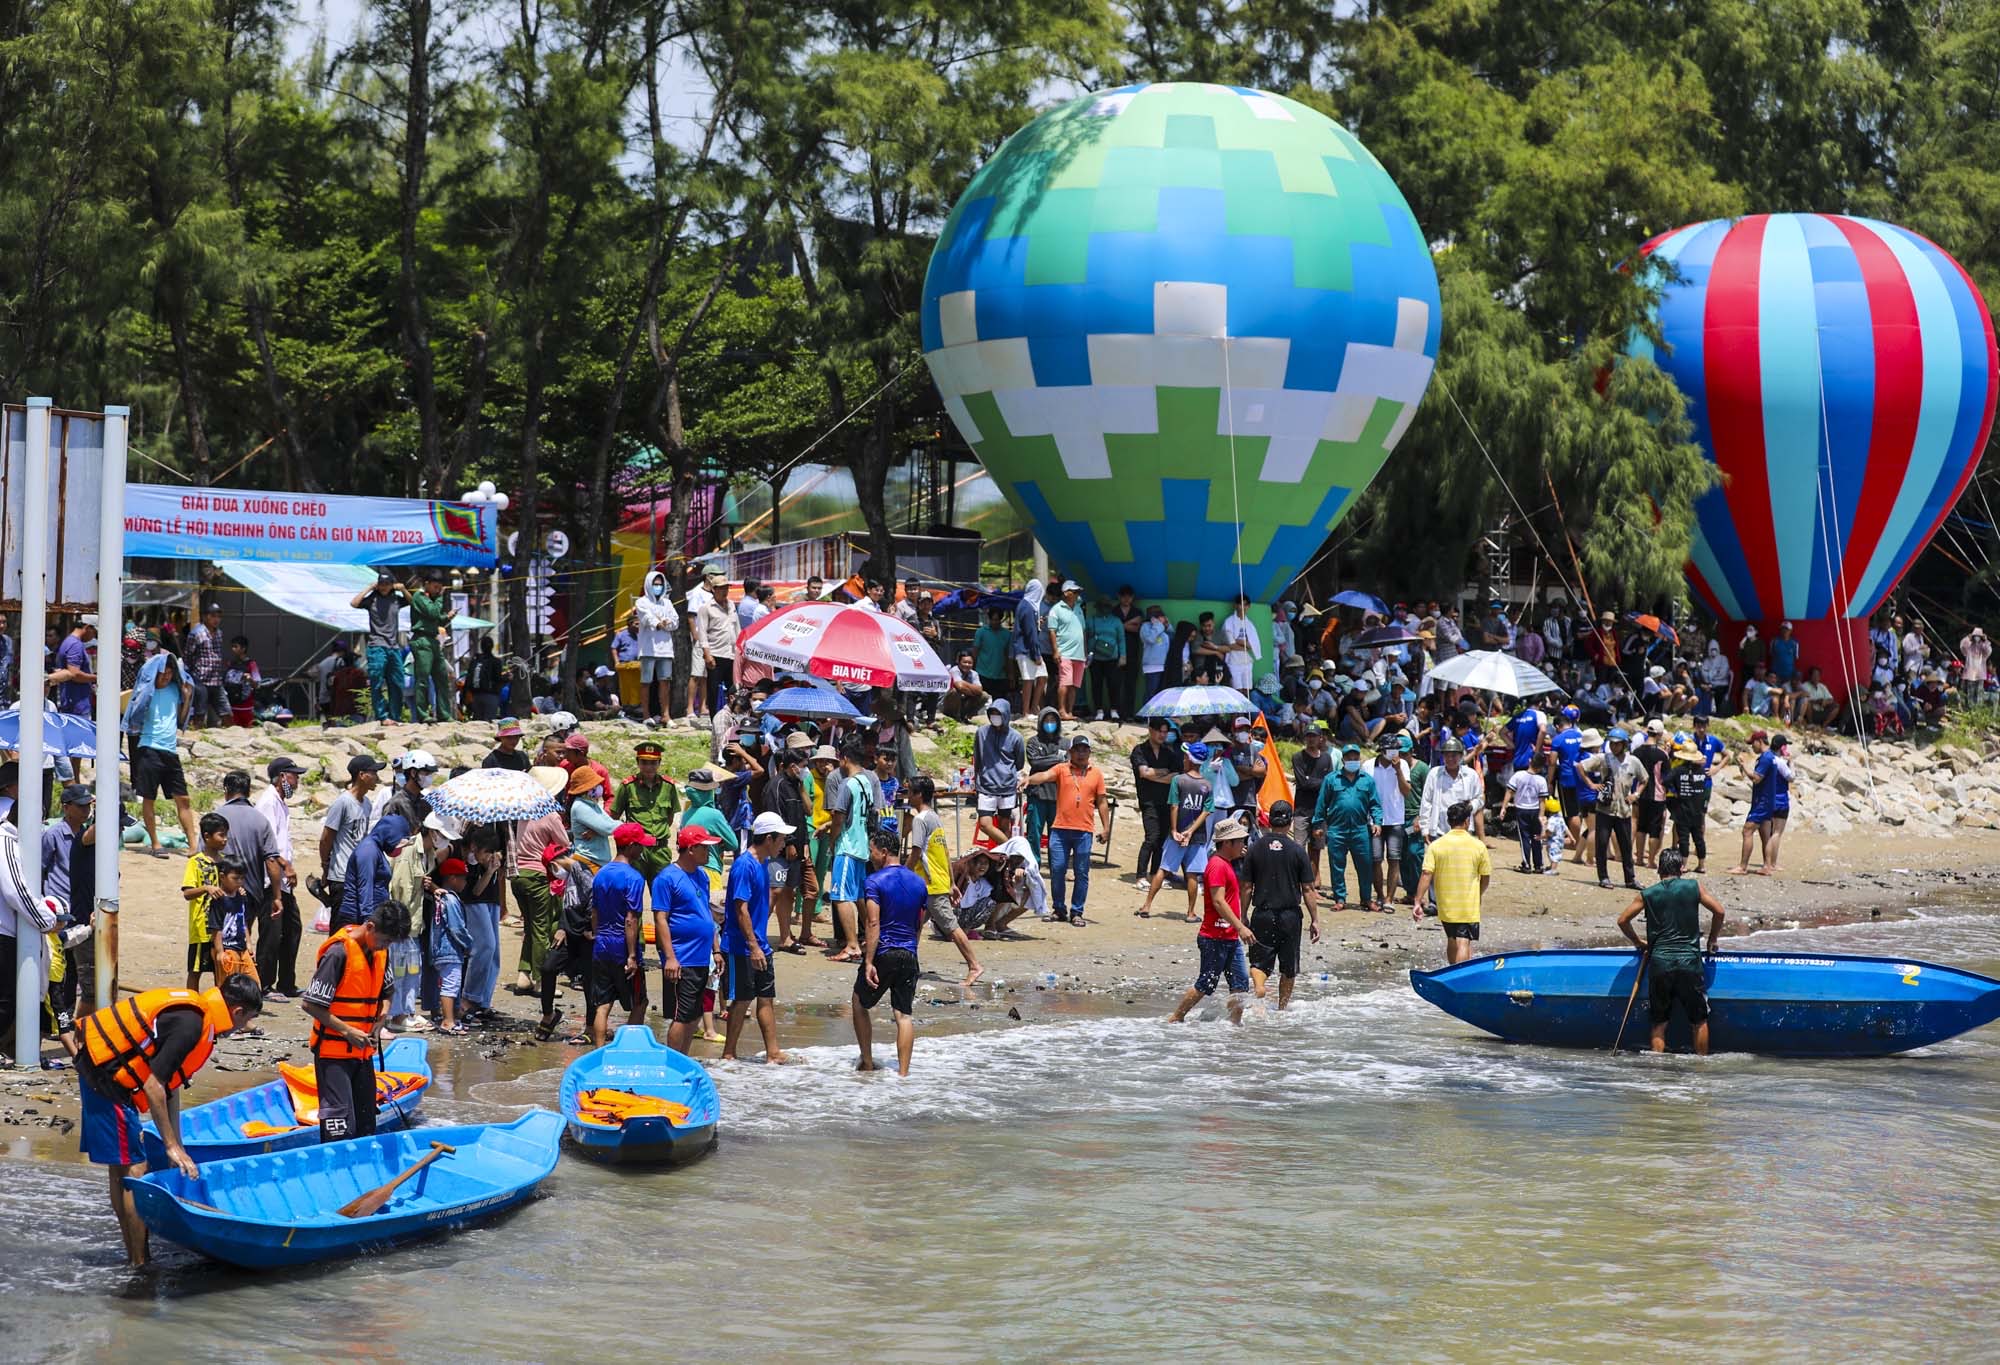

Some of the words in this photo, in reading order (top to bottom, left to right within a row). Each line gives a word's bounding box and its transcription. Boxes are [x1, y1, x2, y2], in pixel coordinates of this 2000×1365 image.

[213, 522, 264, 538] NGHINH
[269, 522, 296, 540] ÔNG
[392, 530, 423, 544] 2023
[832, 664, 849, 677] BIA
[850, 667, 872, 681] VIỆT
[776, 870, 787, 881] 08
[1495, 957, 1504, 970] 2
[1902, 964, 1921, 986] 2
